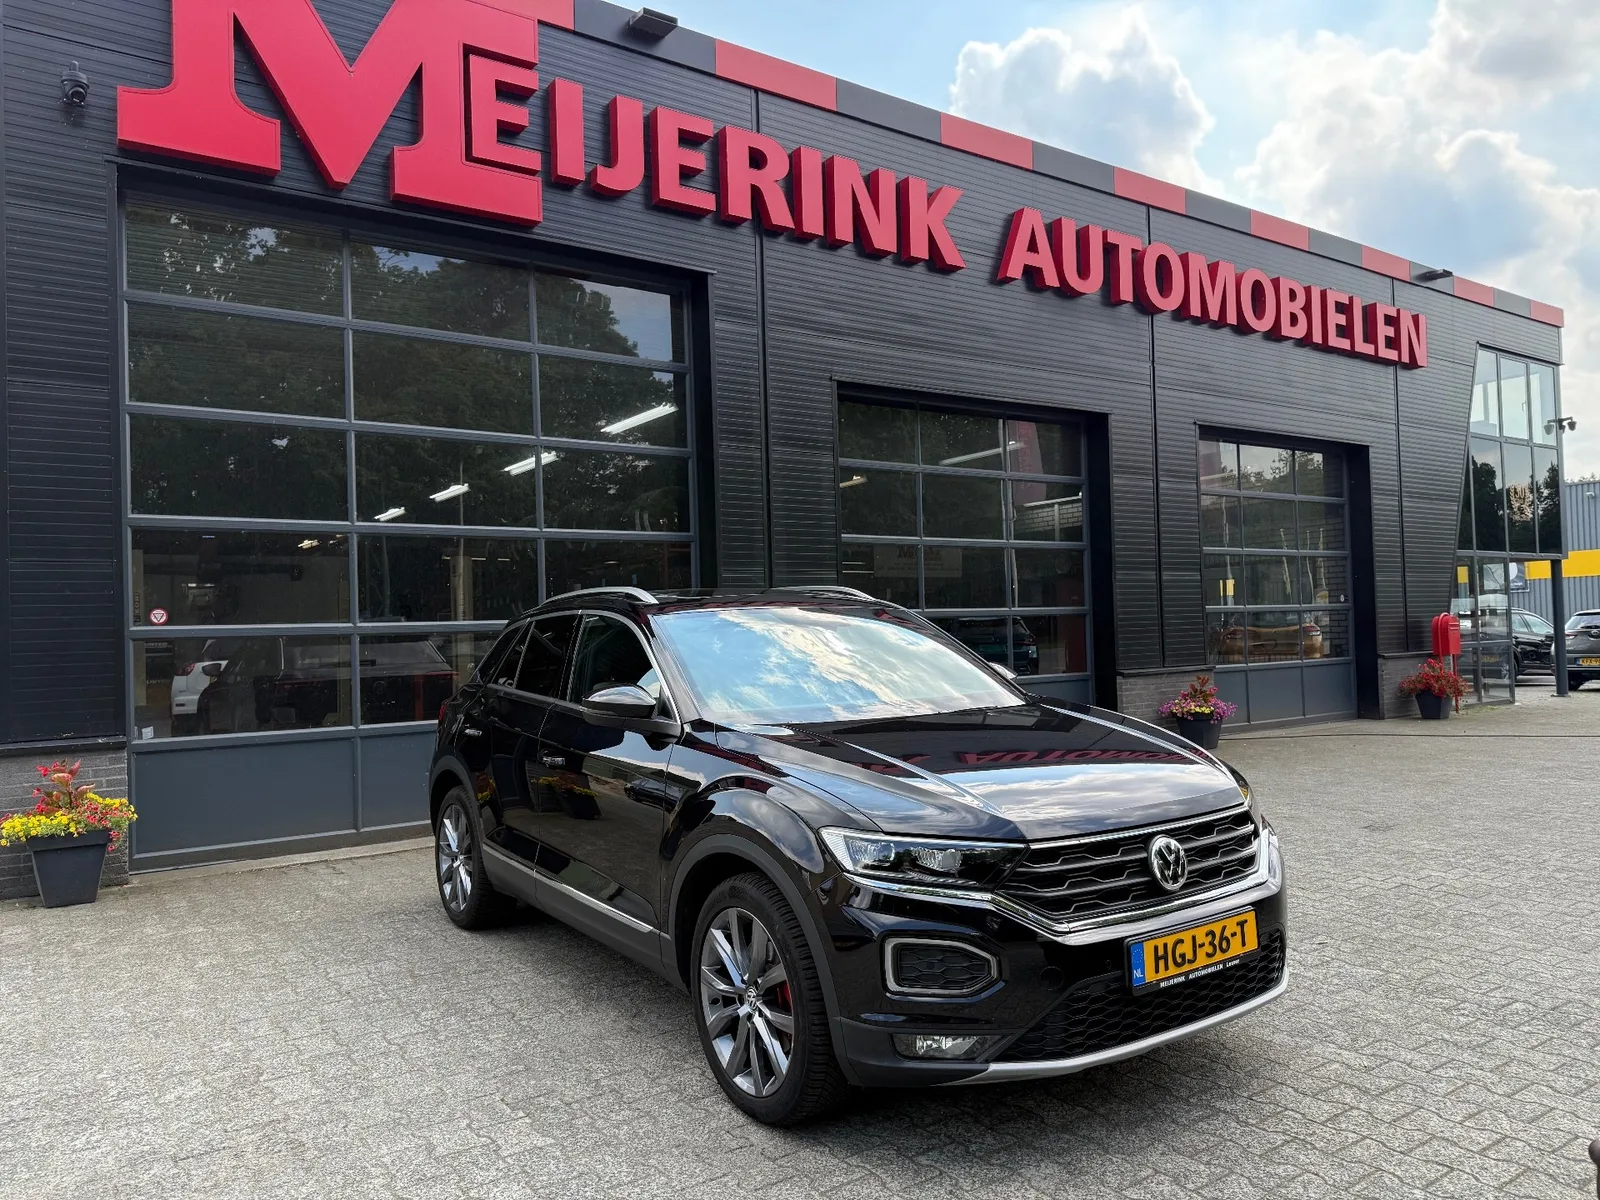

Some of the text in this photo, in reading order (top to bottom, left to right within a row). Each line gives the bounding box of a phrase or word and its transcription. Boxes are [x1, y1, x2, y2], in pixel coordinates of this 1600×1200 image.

[117, 0, 1428, 368] MEIJERINK AUTOMOBIELEN
[1133, 969, 1144, 979] NL
[1154, 920, 1248, 974] HGJ-36-T
